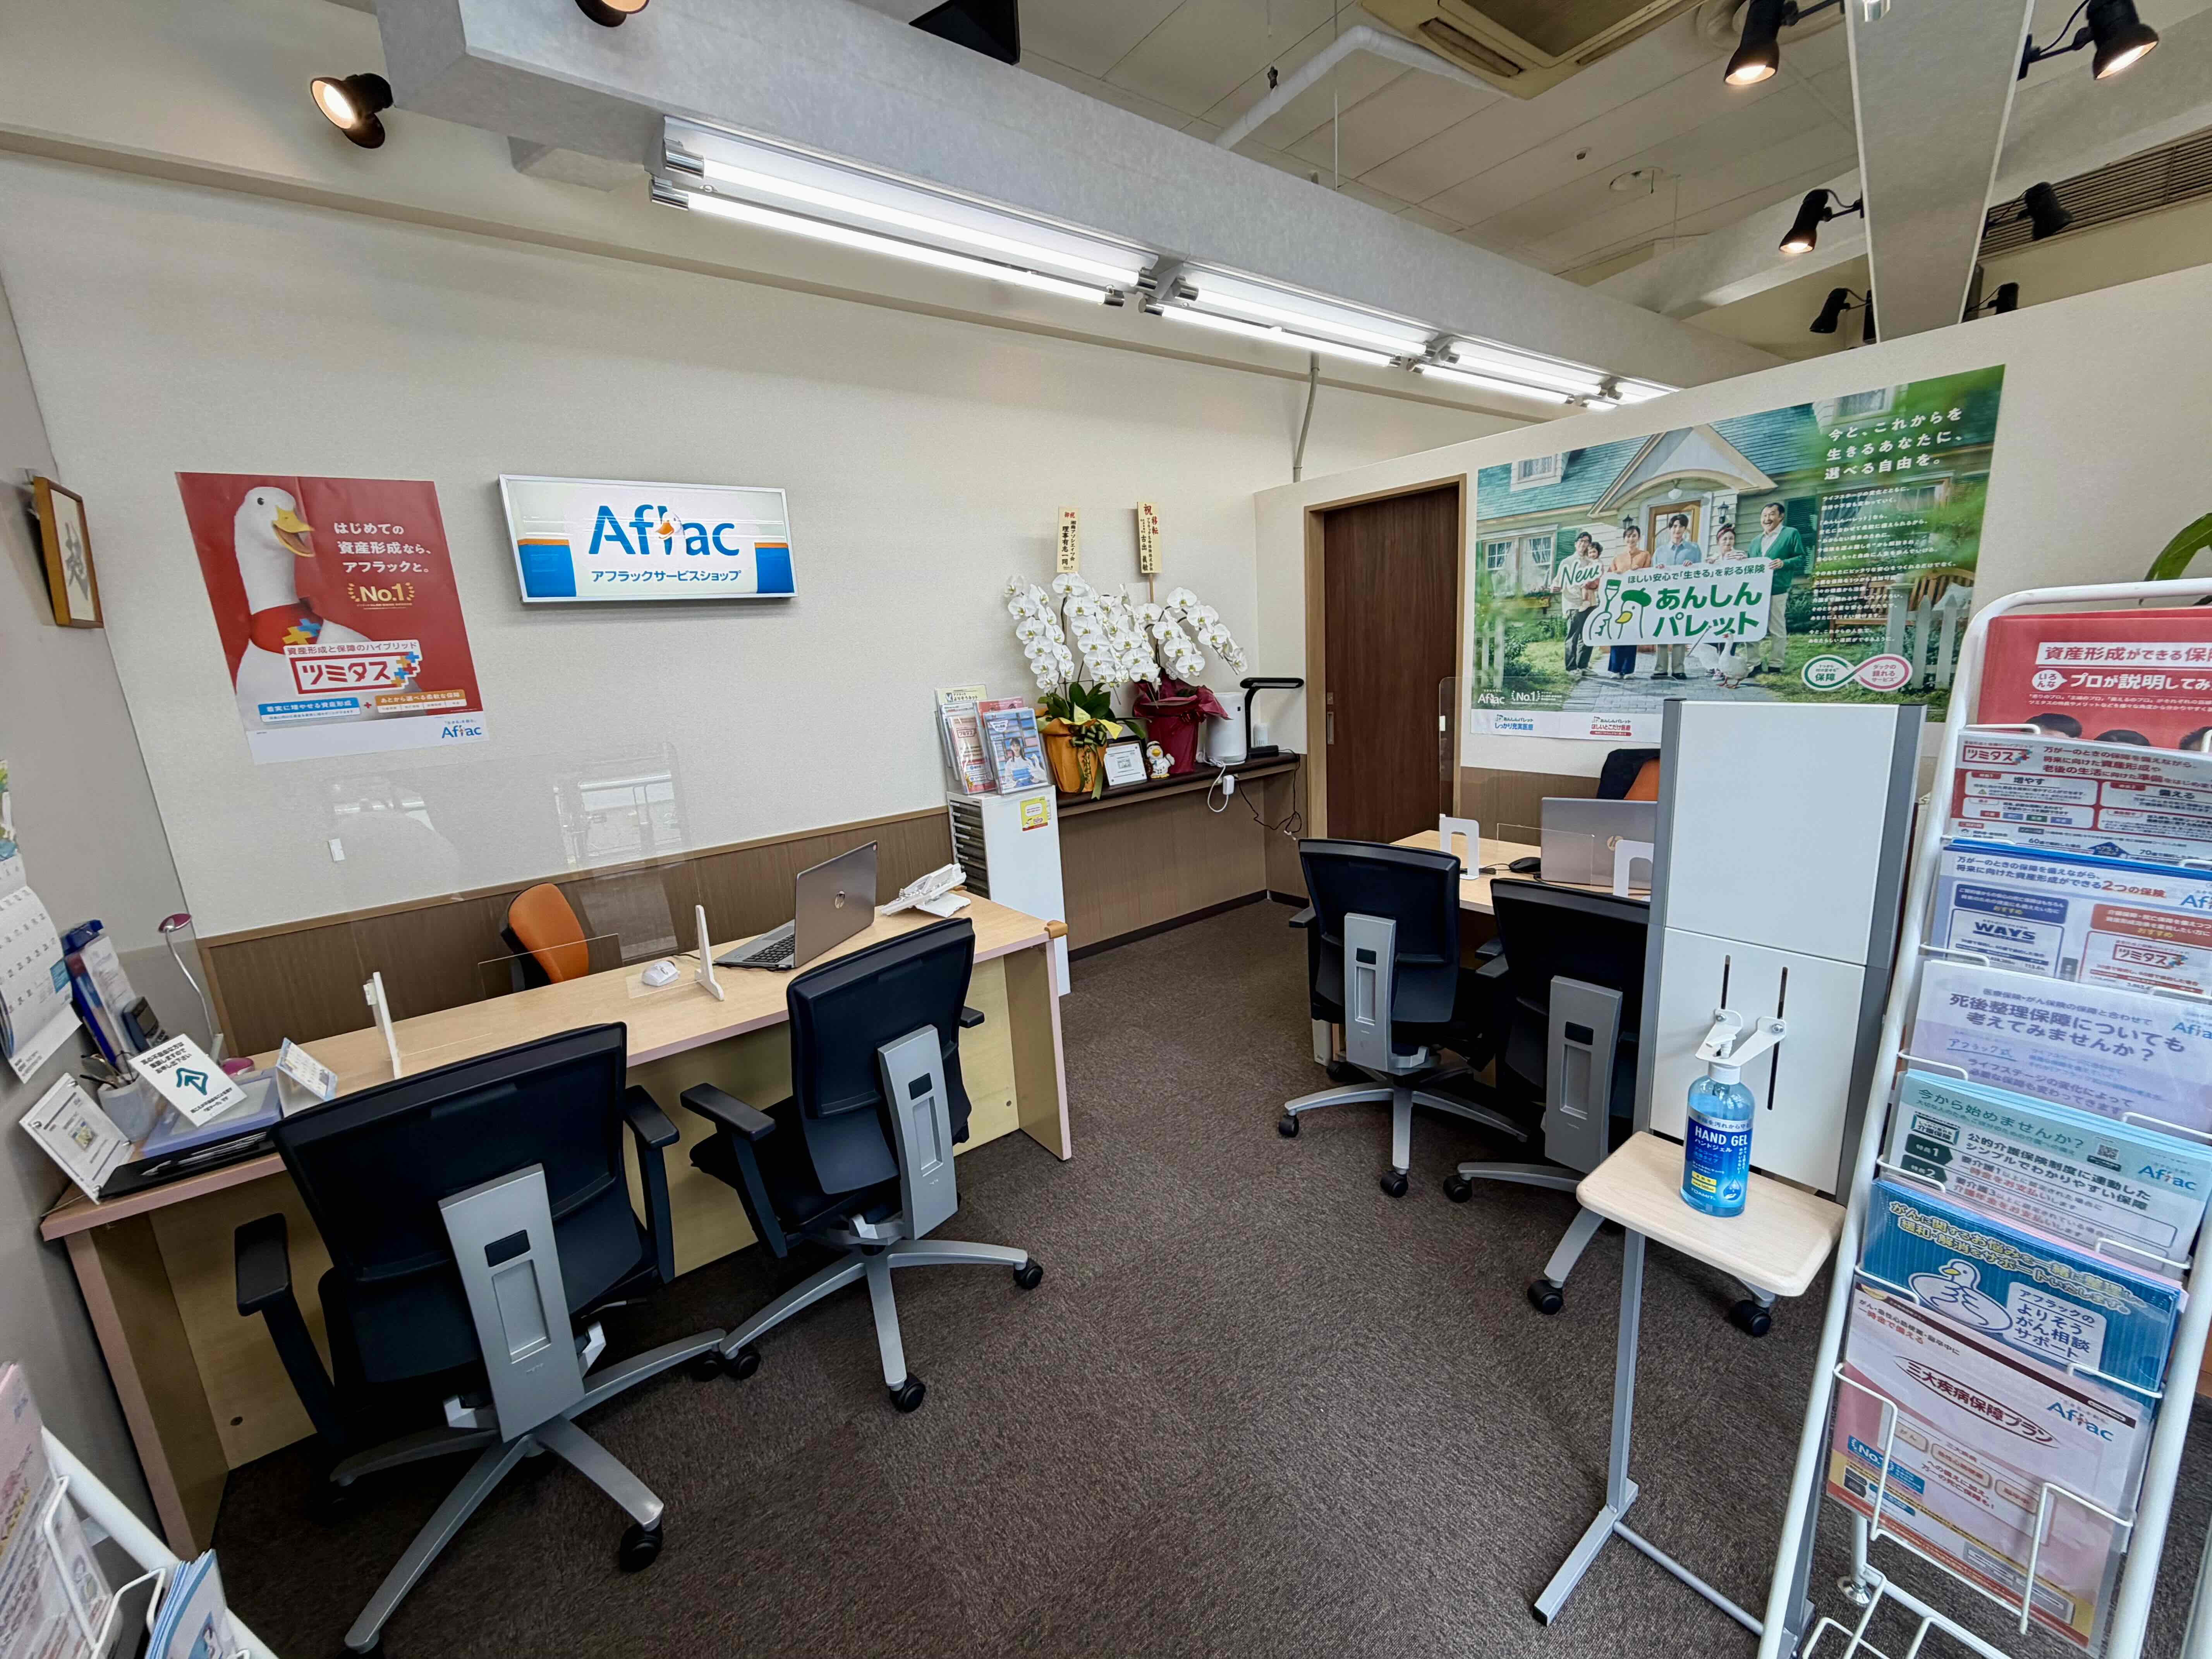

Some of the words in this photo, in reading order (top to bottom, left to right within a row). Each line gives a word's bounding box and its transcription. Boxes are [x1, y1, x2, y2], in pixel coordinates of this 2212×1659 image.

[1829, 407, 1962, 441] 今と、これからを
[1826, 431, 1962, 461] 生きるあなたに、
[1824, 453, 1940, 480] 選べる自由を。
[334, 522, 404, 534] はじめての
[589, 504, 739, 556] Aflac
[337, 541, 431, 554] 資産形成なら、
[343, 561, 429, 573] アフラックと。
[592, 570, 741, 582] アフラックサービスショップ
[1562, 565, 1599, 587] New
[1628, 564, 1765, 584] ほしい安心で「生きる」を彩る保険
[359, 583, 404, 602] No.1
[1656, 582, 1762, 610] あんしん
[1652, 611, 1760, 637] パレット
[287, 642, 417, 655] 資産形成と保障のハイブリッド
[2045, 647, 2212, 662] 資産形成ができる保
[302, 661, 391, 685] ツミタス
[1815, 673, 1835, 682] 保障
[2070, 672, 2212, 690] プロが説明してみ
[1478, 693, 1505, 704] Aflac
[441, 725, 481, 738] Aflac
[1968, 749, 2013, 761] ツミタス
[2013, 777, 2045, 785] 増やす
[1975, 922, 2035, 940] WAYS
[2119, 948, 2168, 965] ツミタス
[1949, 993, 2185, 1053] 死後整理保障についても
[1966, 1012, 2154, 1061] 考えてみませんか？
[1919, 1089, 2084, 1149] 今から始めませんか？
[1695, 1126, 1726, 1145] HAND
[1731, 1135, 1748, 1146] GEL
[1695, 1138, 1732, 1152] ハンドジェル
[2138, 1165, 2197, 1191] Aflac
[2020, 1290, 2095, 1324] アフラックの
[2017, 1304, 2082, 1334] よりそう
[2015, 1327, 2080, 1358] サポート
[2016, 1316, 2090, 1354] がん相談
[1906, 1361, 2054, 1443] 三大疾病保障プラン
[2046, 1401, 2114, 1442] Aflac
